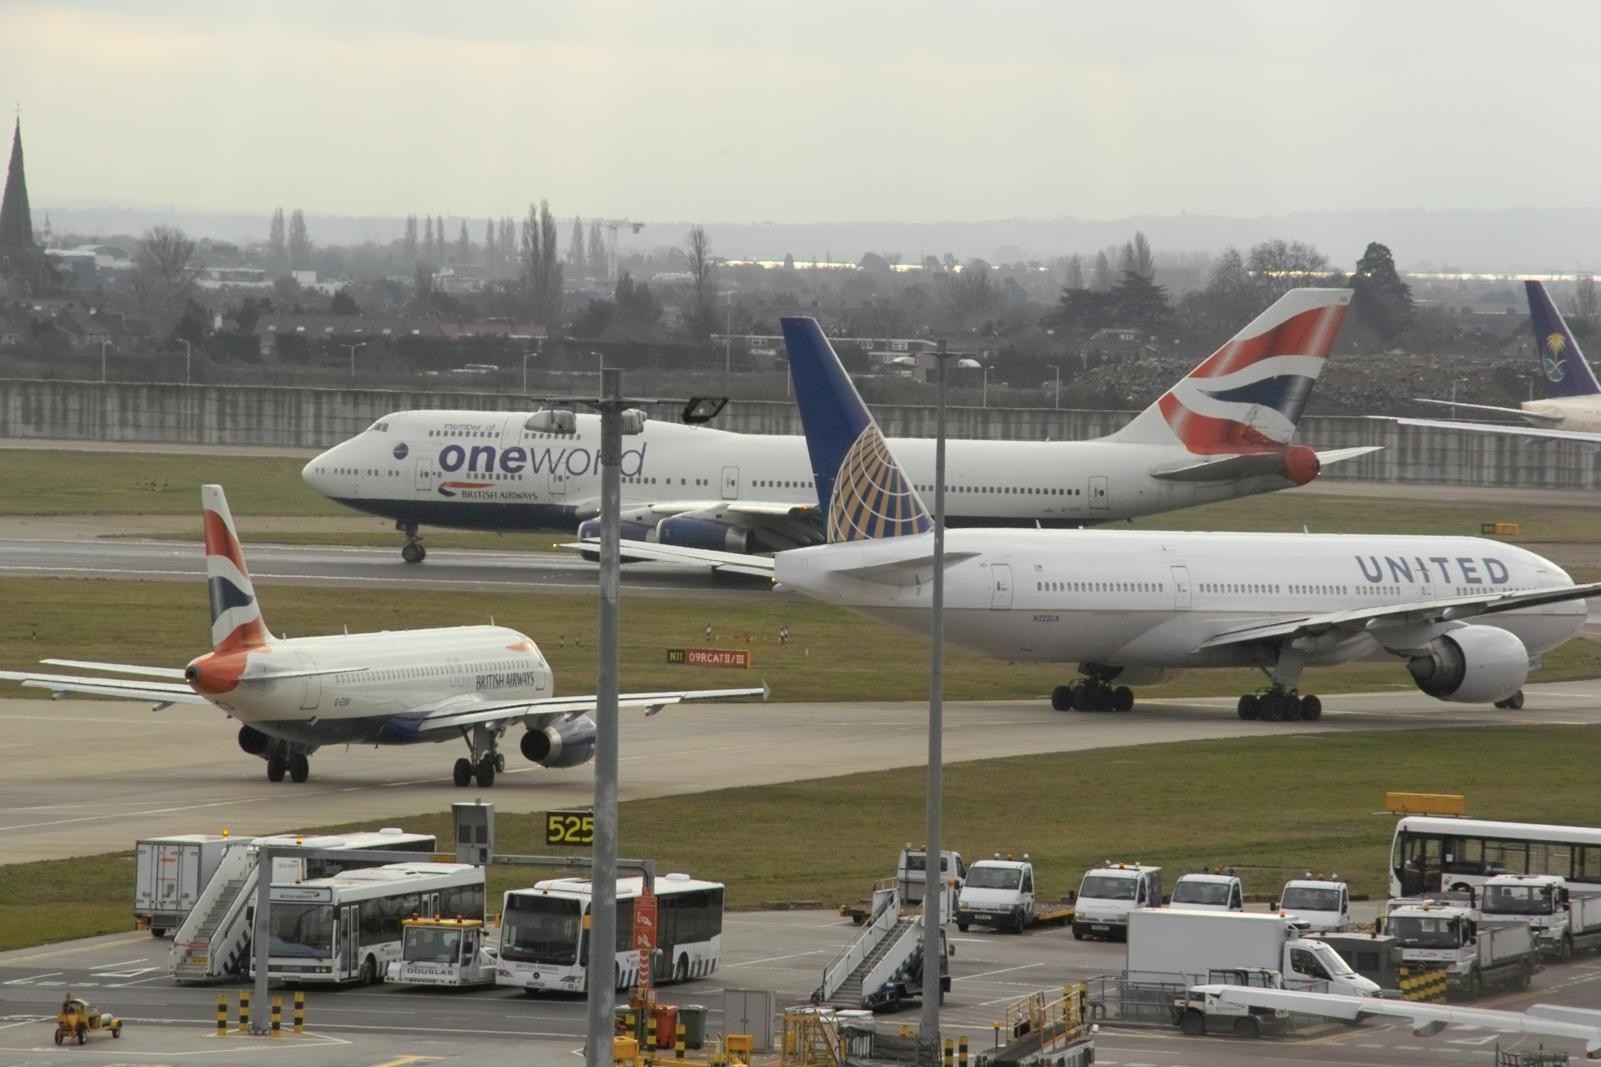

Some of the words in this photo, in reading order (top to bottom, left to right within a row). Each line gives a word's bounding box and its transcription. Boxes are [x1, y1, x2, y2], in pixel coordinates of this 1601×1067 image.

[444, 423, 481, 431] member
[486, 423, 496, 431] of
[438, 441, 647, 477] oneword
[461, 490, 497, 499] BRITISH
[500, 491, 538, 500] AIRWAYS
[1355, 555, 1510, 584] UNITED
[476, 673, 504, 690] BRITISH
[505, 671, 535, 688] AIRWAYS
[549, 815, 594, 842] 525
[407, 968, 454, 976] DOUGLAS
